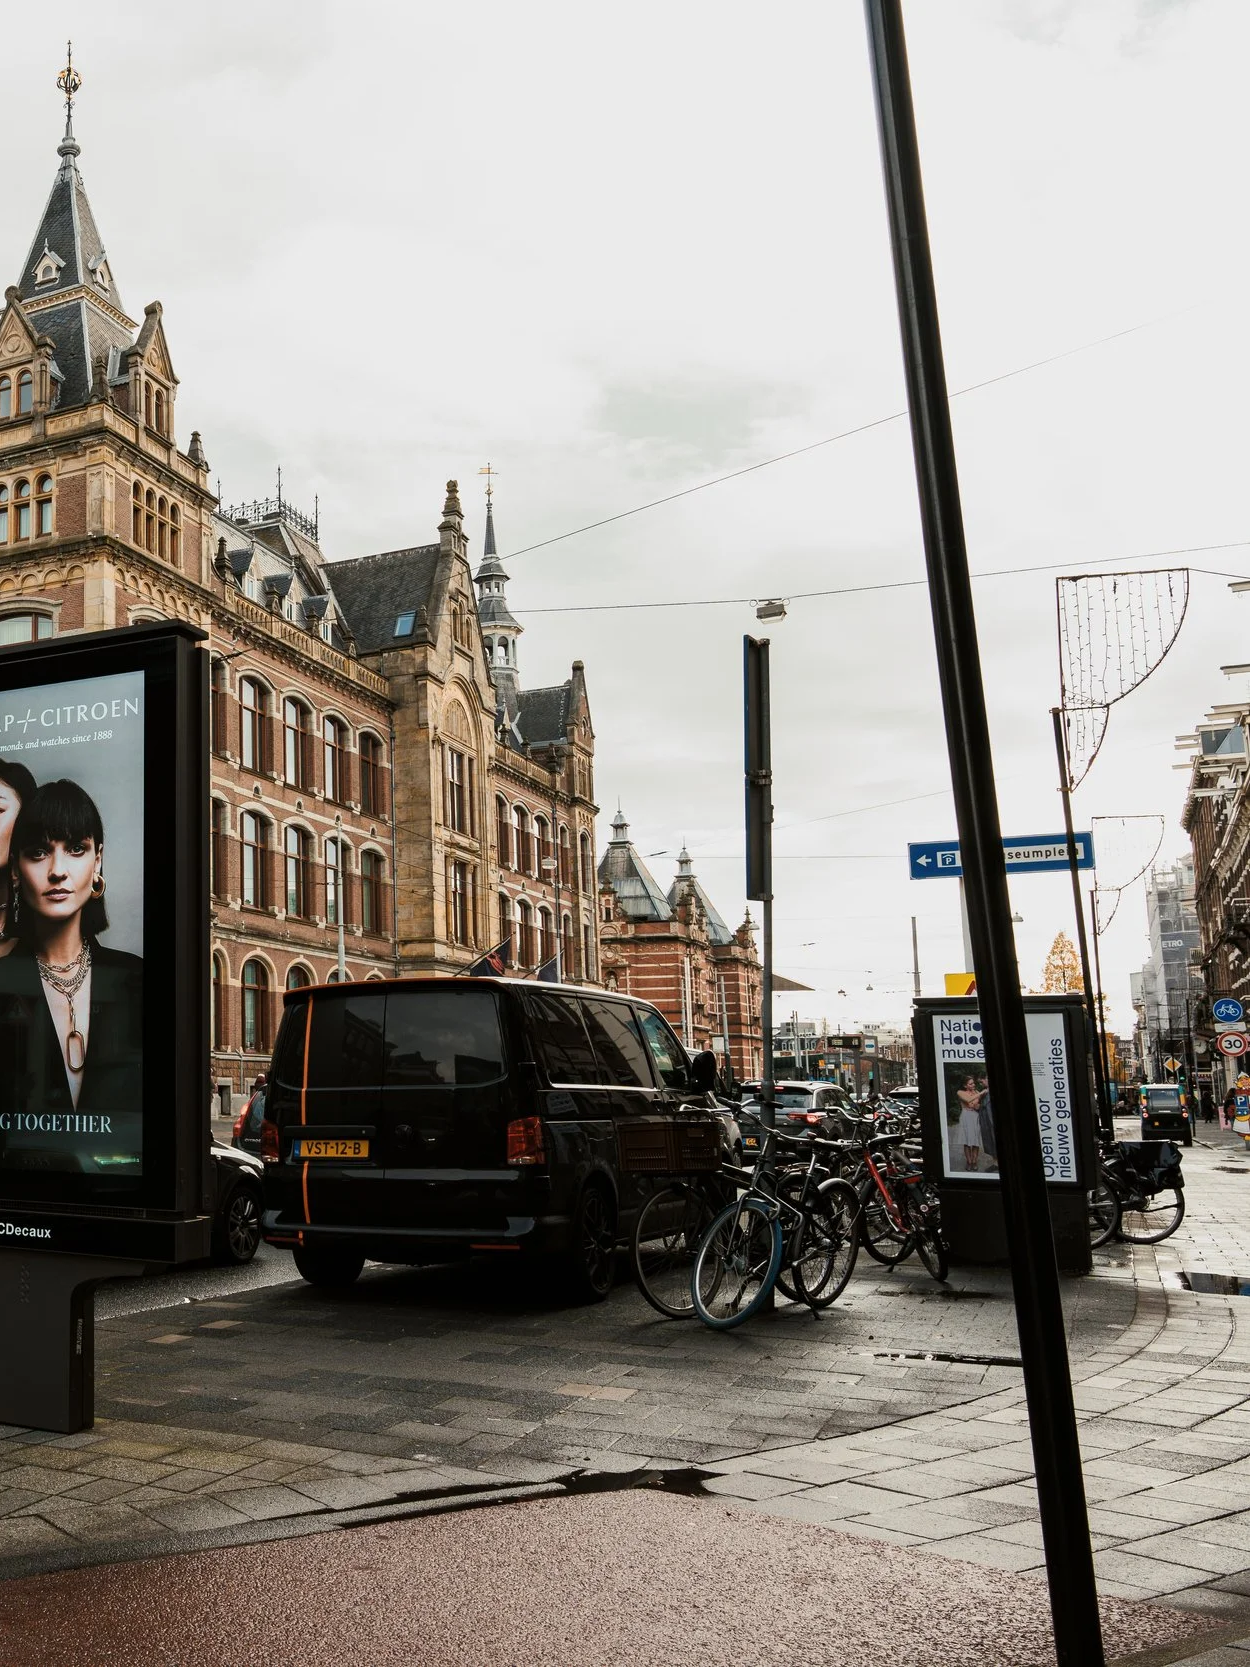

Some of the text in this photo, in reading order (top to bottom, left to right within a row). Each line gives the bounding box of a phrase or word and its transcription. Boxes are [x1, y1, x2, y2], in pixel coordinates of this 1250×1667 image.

[40, 697, 139, 727] CITROEN
[25, 738, 39, 749] and
[41, 736, 70, 748] watches
[71, 733, 91, 744] since
[93, 729, 113, 741] 1888
[940, 1019, 982, 1032] Natio
[941, 1032, 984, 1046] Holoc
[1224, 1039, 1243, 1049] 30
[942, 1048, 986, 1059] muse
[1038, 1097, 1052, 1132] voor
[1048, 1038, 1072, 1179] nieuwe generaties
[13, 1113, 113, 1134] TOGETHER
[306, 1141, 361, 1155] VST-12-B
